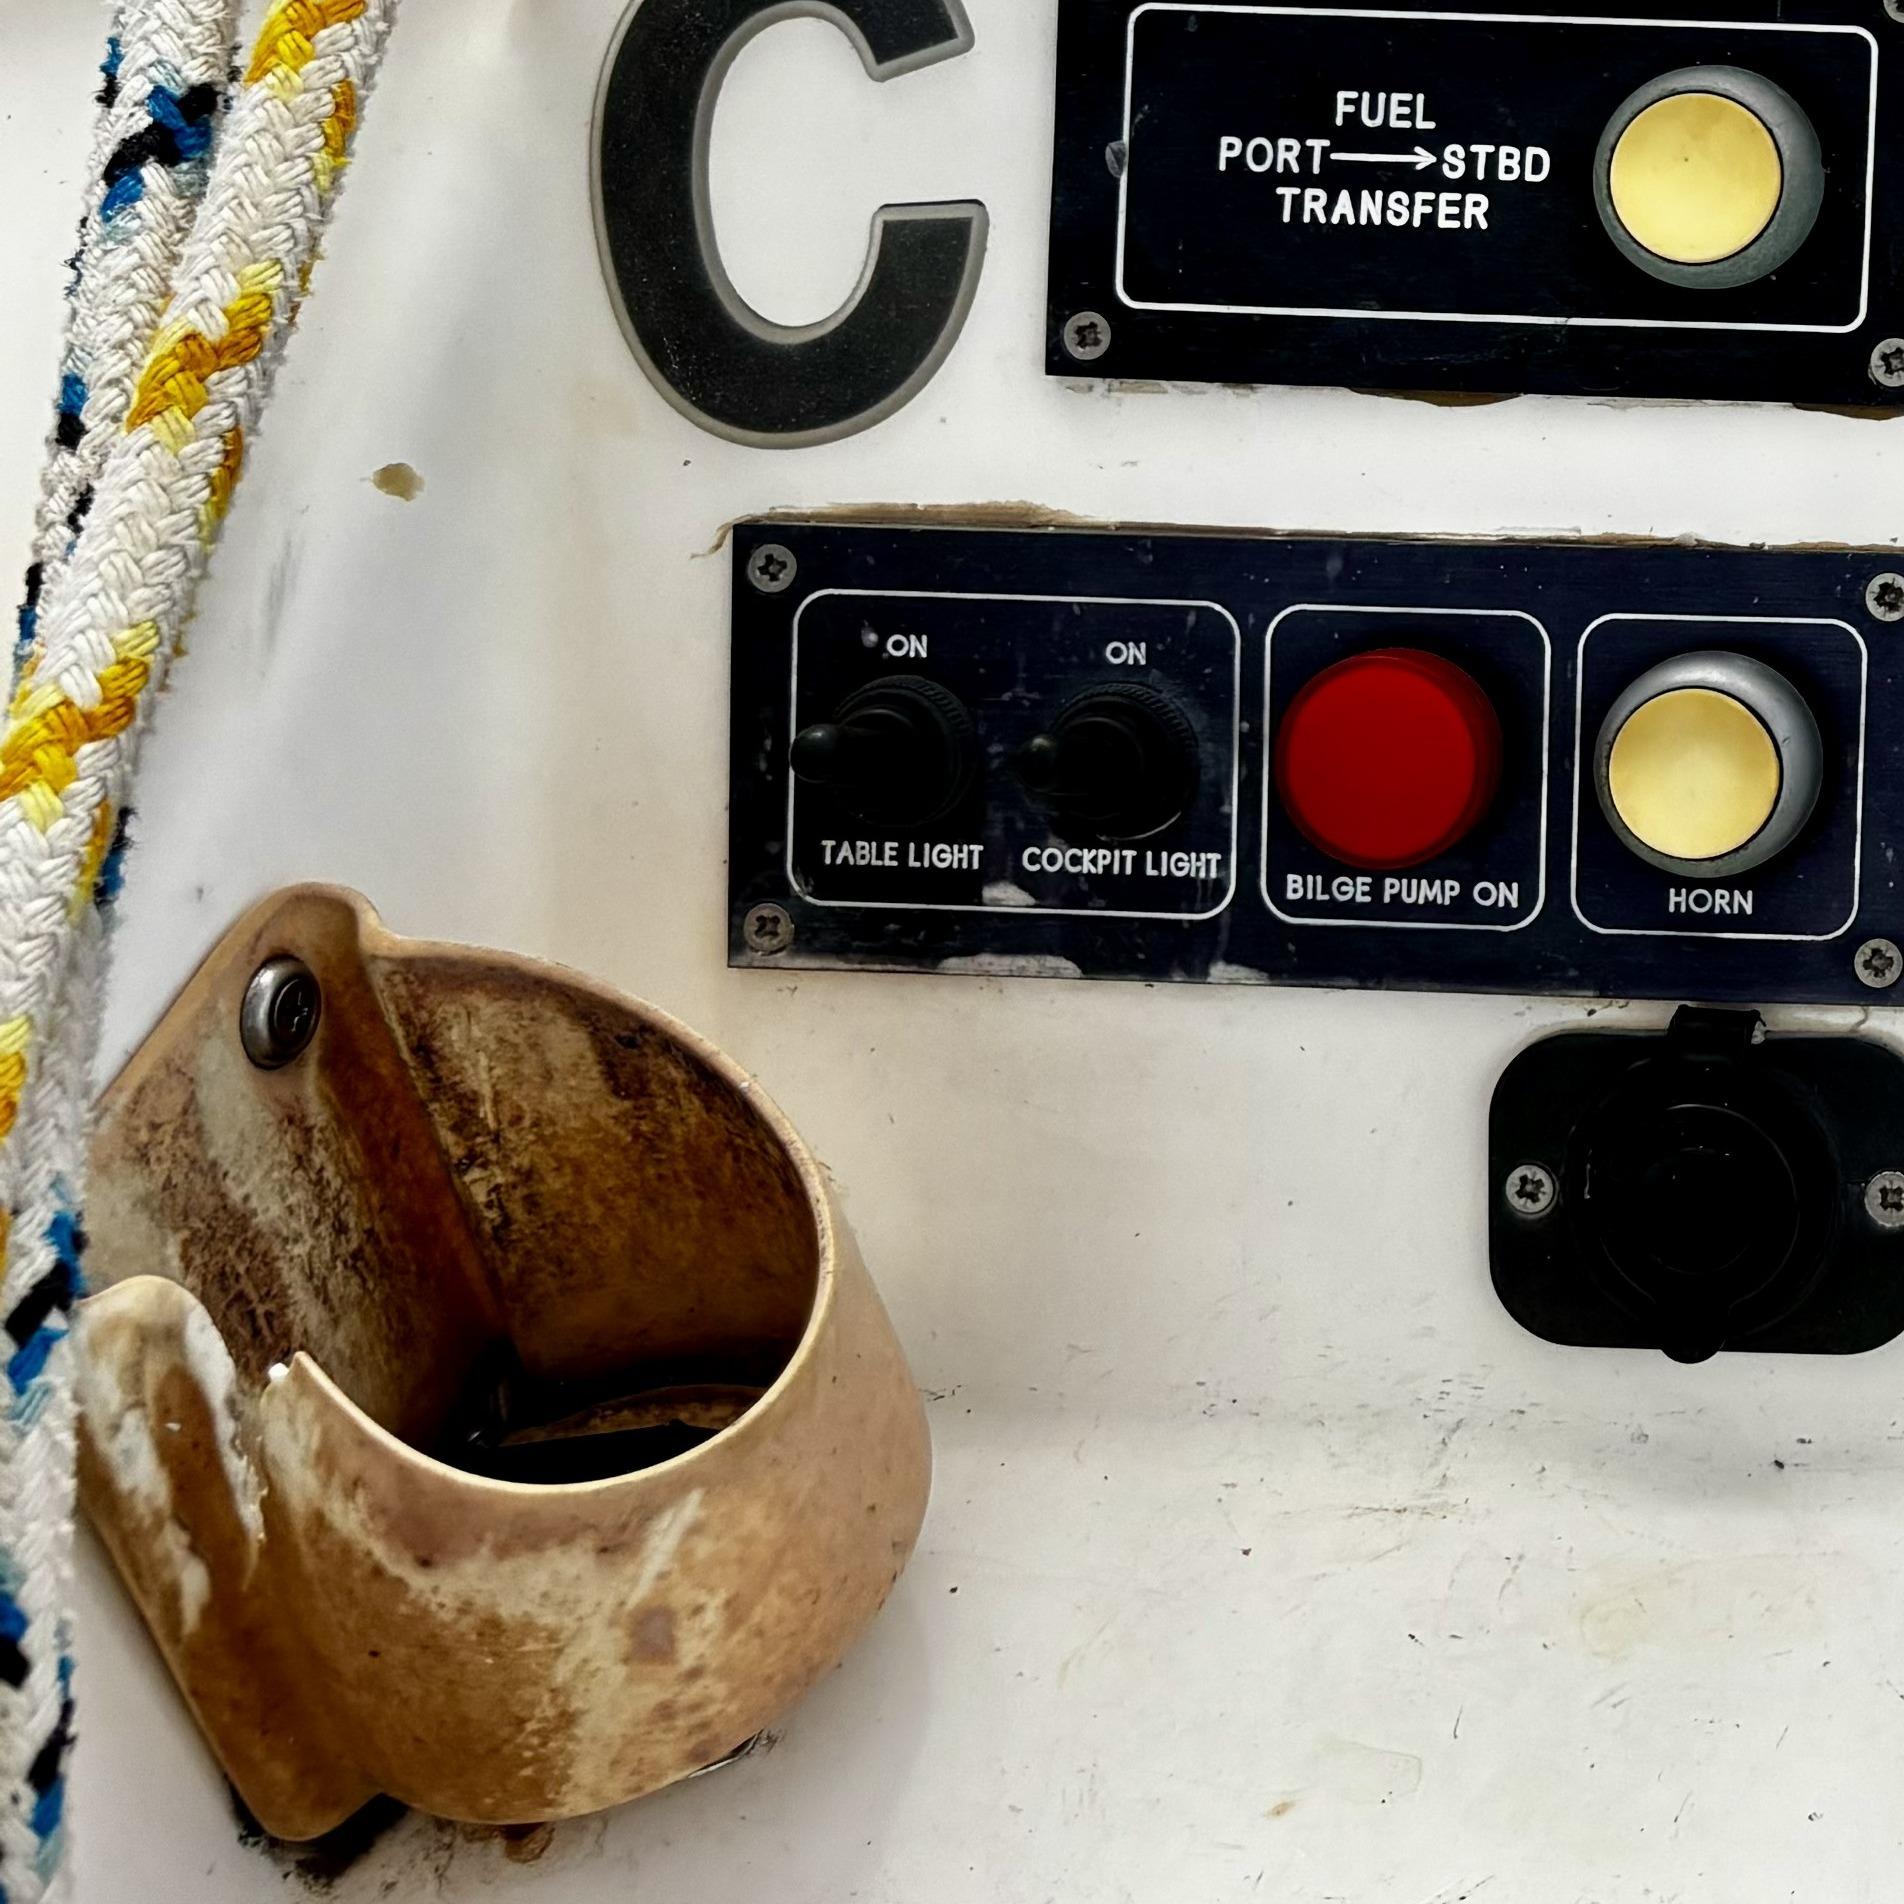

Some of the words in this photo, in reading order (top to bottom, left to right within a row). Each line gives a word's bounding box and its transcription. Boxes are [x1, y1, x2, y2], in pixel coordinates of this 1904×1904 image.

[1334, 90, 1436, 130] FUEL
[1219, 136, 1332, 176] PORT
[1442, 143, 1552, 183] STBD
[1276, 187, 1490, 230] TRANSFER
[886, 634, 928, 658] ON
[1105, 641, 1147, 666] ON
[821, 839, 899, 867] TABLE
[908, 842, 984, 870] LIGHT
[1021, 846, 1138, 875] COCKPIT
[1145, 850, 1222, 878] LIGHT
[1286, 873, 1372, 903] BILGE
[1382, 876, 1461, 905] PUMP
[1472, 881, 1519, 908] ON
[1668, 887, 1753, 915] HORN
